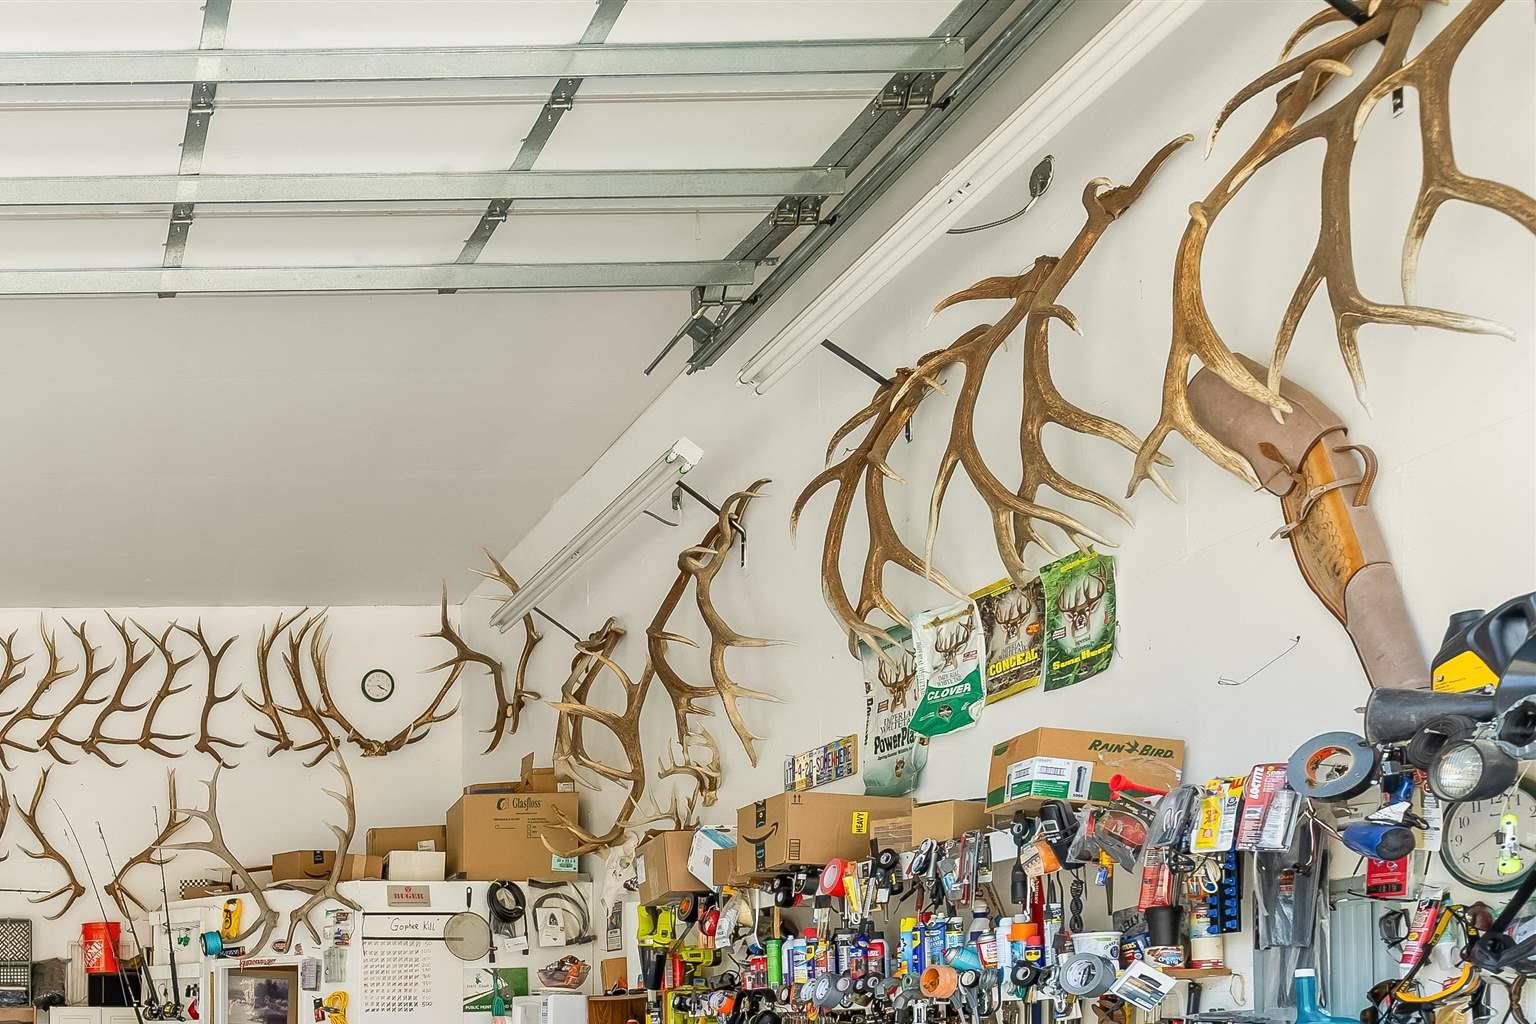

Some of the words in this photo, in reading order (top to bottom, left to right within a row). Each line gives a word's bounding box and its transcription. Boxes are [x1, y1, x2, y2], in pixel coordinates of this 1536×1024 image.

[988, 648, 1039, 678] CONCEAL
[927, 682, 972, 702] CLOVER
[874, 727, 917, 755] PowerPla
[1088, 739, 1126, 753] RAIN
[1139, 744, 1175, 759] BIRD
[1249, 766, 1265, 800] LOCTITE
[512, 797, 541, 811] Glasfloss
[856, 812, 864, 832] HEAVY
[1459, 816, 1470, 829] 10
[1478, 862, 1486, 875] 7
